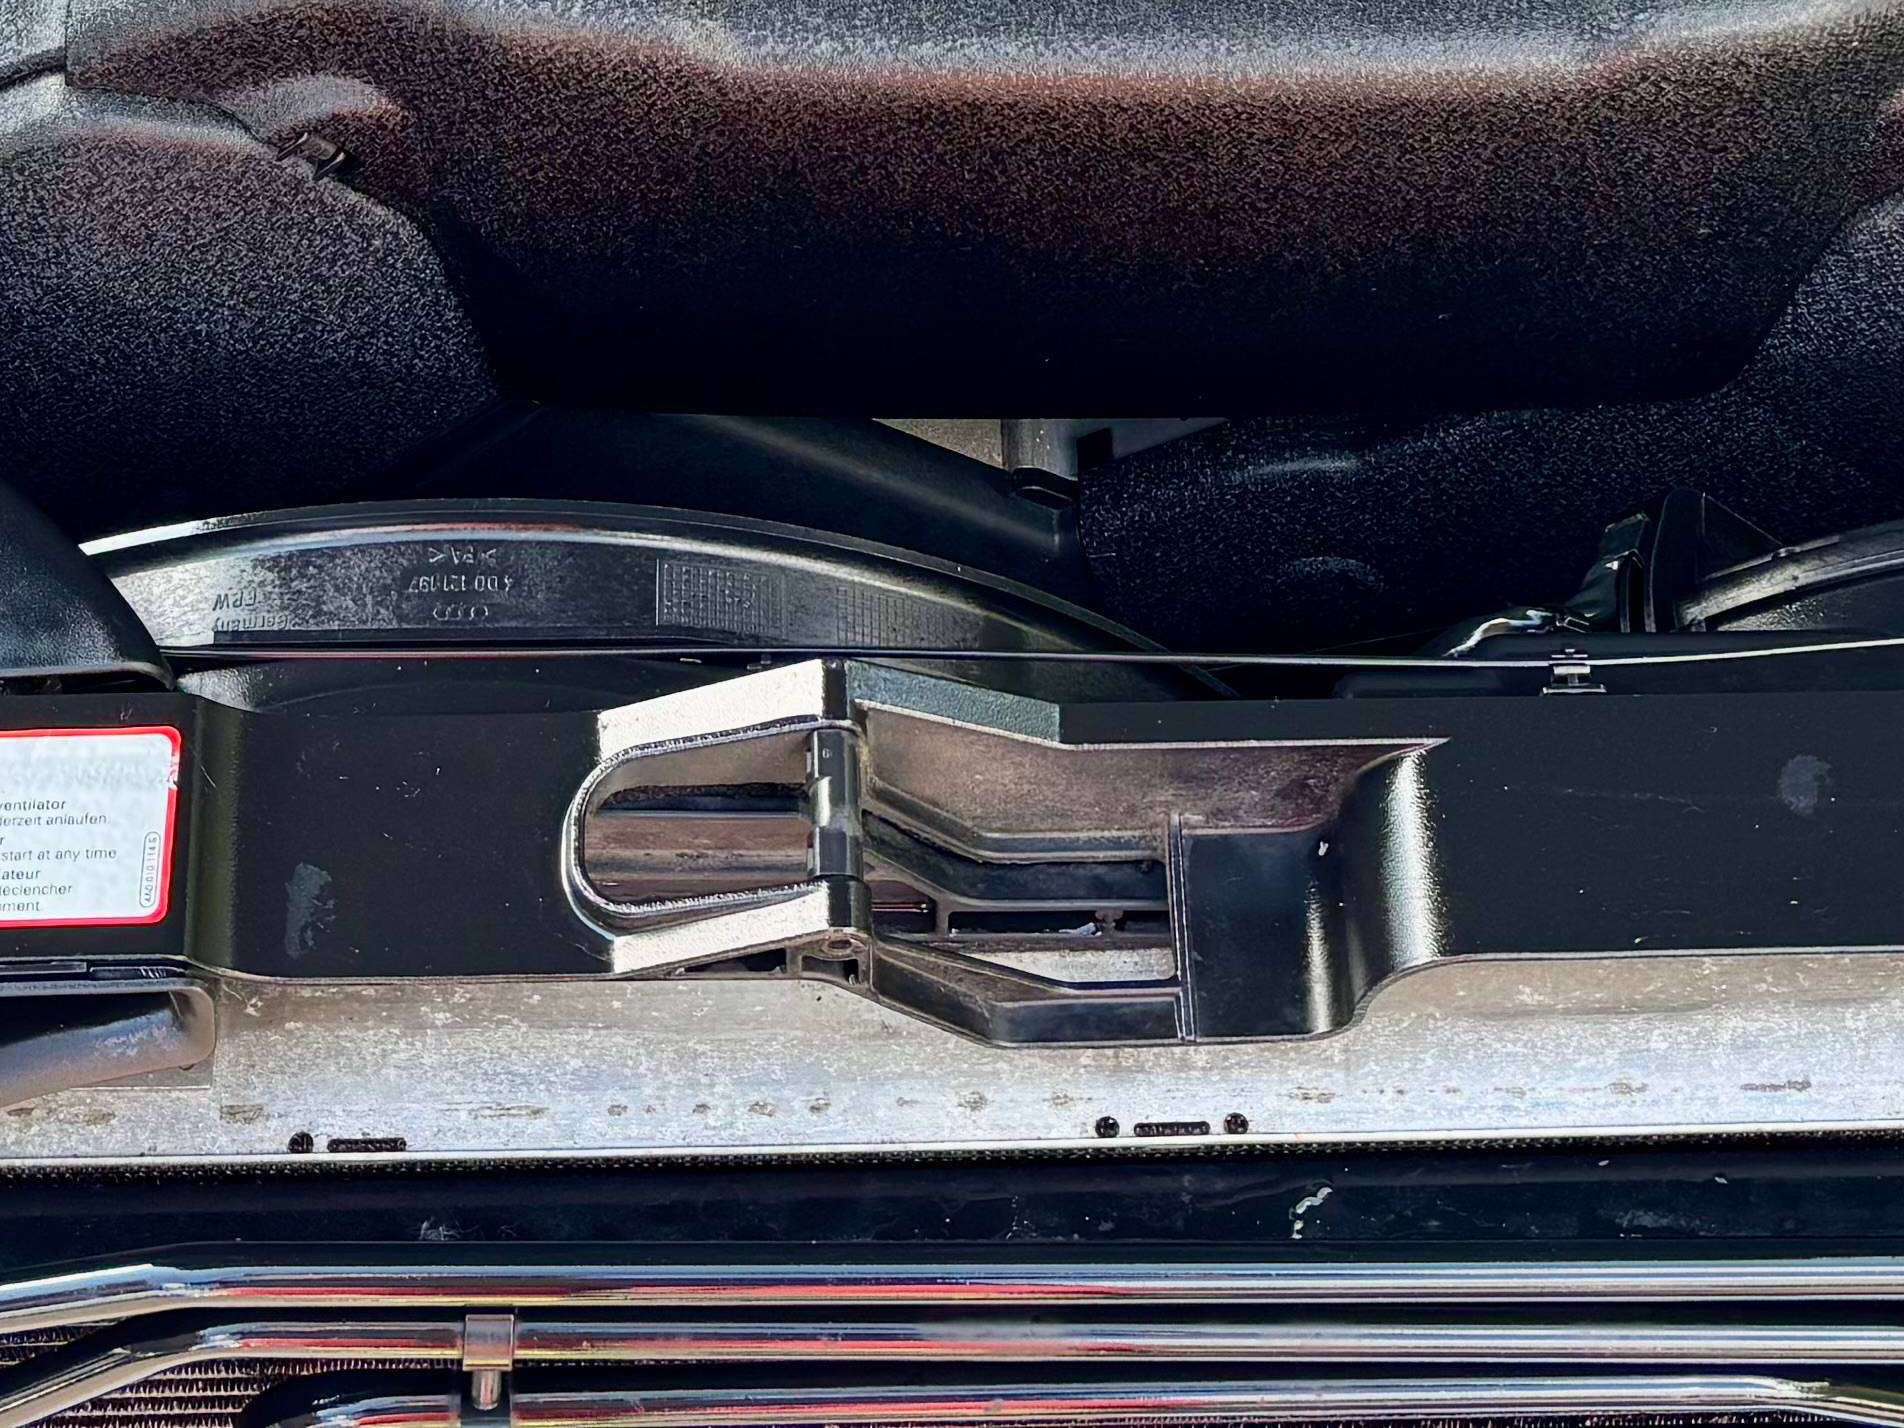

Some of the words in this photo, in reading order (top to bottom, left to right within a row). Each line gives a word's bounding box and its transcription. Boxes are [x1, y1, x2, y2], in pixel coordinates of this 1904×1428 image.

[1, 849, 33, 863] start
[37, 848, 52, 861] at
[54, 849, 81, 863] any
[85, 847, 117, 861] time
